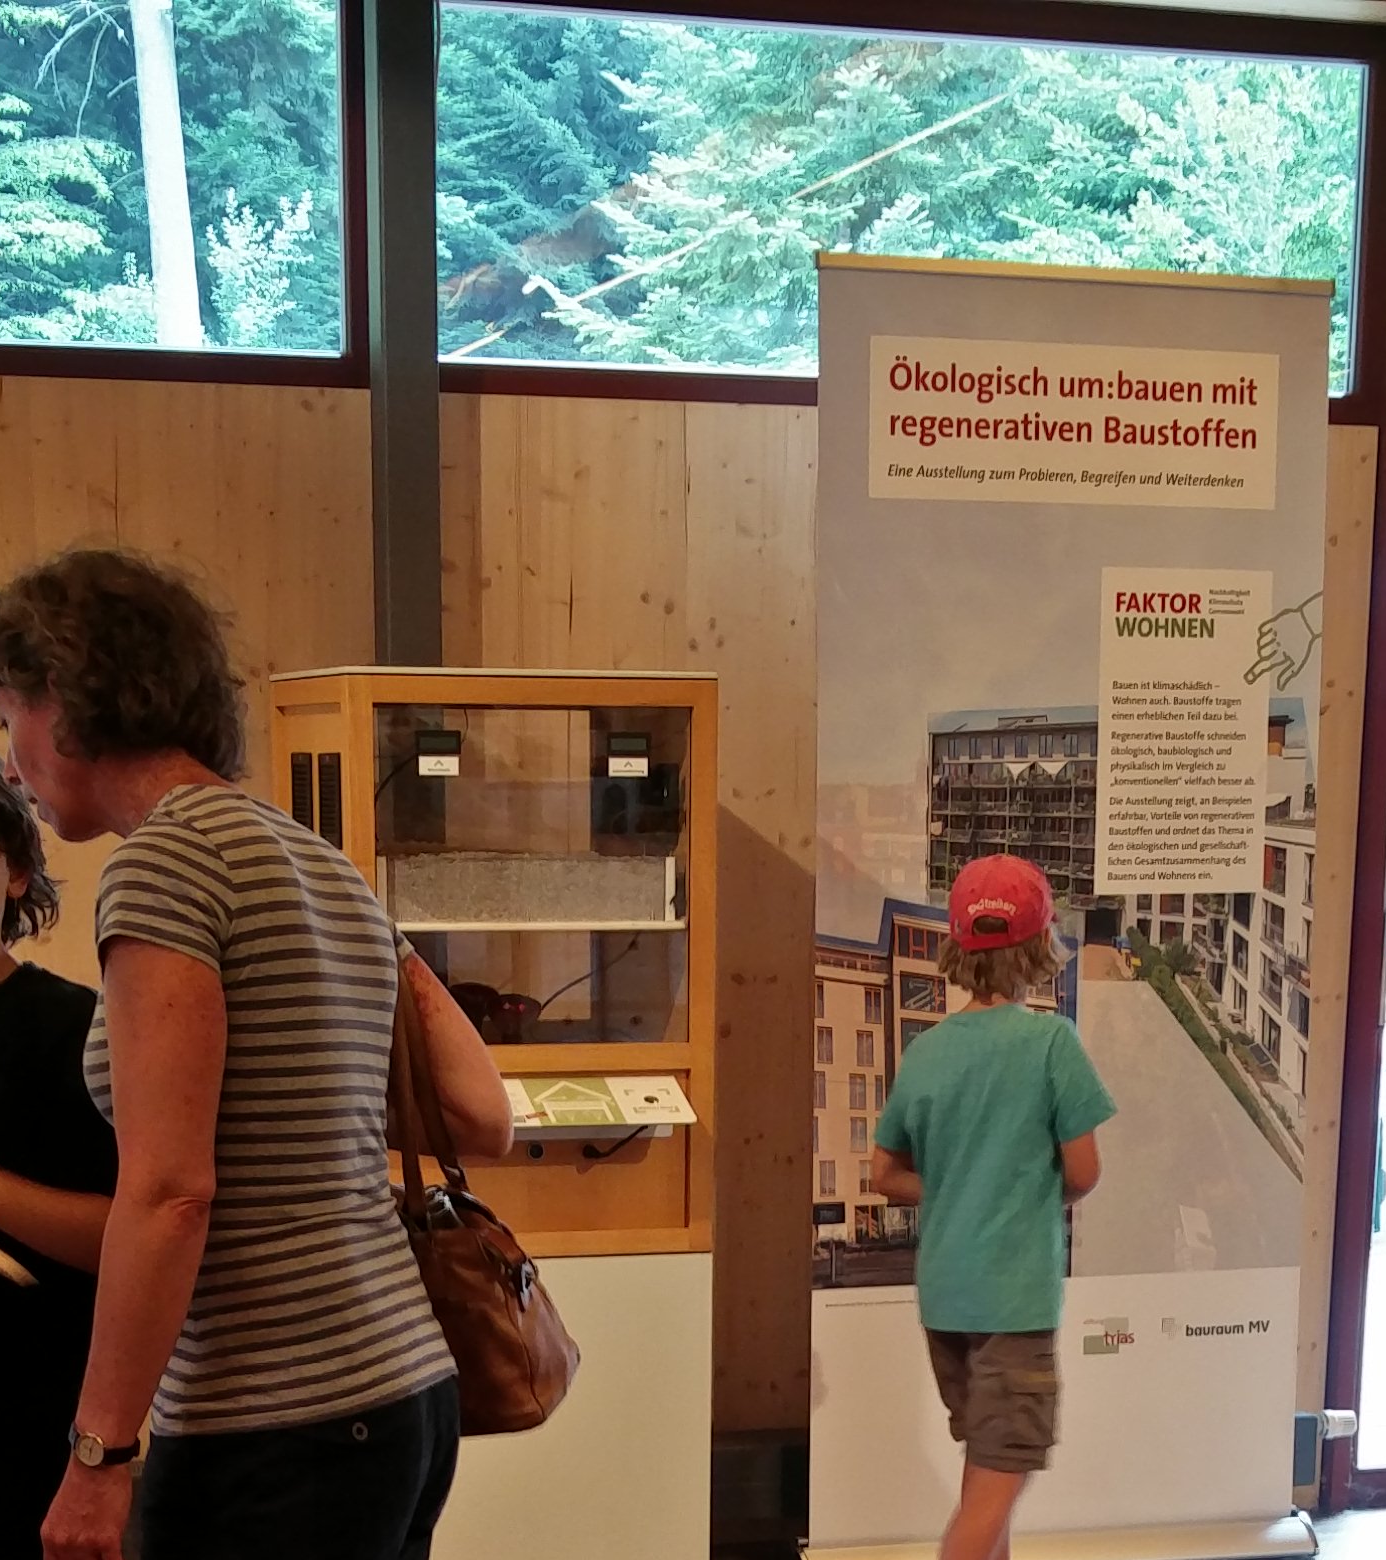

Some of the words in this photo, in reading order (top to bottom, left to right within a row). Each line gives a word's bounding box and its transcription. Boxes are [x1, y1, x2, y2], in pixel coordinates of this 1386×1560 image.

[889, 355, 1048, 403] Ökologisch
[1059, 370, 1202, 403] um:bauen
[1213, 377, 1257, 405] mit
[889, 412, 1092, 447] regenerativen
[1104, 416, 1257, 449] Baustoffen
[888, 464, 913, 478] Eine
[916, 465, 985, 483] Ausstellung
[989, 470, 1015, 481] zum
[1019, 467, 1077, 485] Probieren,
[1081, 469, 1135, 489] Begreifen
[1139, 472, 1162, 486] und
[1165, 472, 1244, 488] Weiterdenken
[1116, 592, 1201, 613] FAKTOR
[1116, 617, 1214, 638] WOHNEN
[1113, 681, 1138, 689] Bauen
[1141, 681, 1150, 689] ist
[1153, 681, 1212, 690] klimaschädlich
[1113, 696, 1147, 705] Wohnen
[1173, 696, 1213, 705] Baustoffe
[1216, 697, 1241, 708] tragen
[1112, 712, 1134, 720] einen
[1137, 712, 1184, 720] erheblichen
[1188, 712, 1200, 720] Teil
[1203, 712, 1221, 720] dazu
[1111, 731, 1163, 742] Regenerative
[1166, 730, 1204, 740] Baustoffe
[1207, 731, 1246, 740] schneiden
[1158, 746, 1213, 758] baubiologisch
[1216, 747, 1232, 755] und
[1110, 761, 1159, 773] physikalisch
[1176, 762, 1213, 773] Vergleich
[1185, 776, 1215, 785] vielfach
[1218, 776, 1242, 785] besser
[1109, 796, 1123, 805] Die
[1125, 796, 1173, 808] Ausstellung
[1151, 811, 1181, 820] Vorteile
[1201, 812, 1255, 822] regenerativen
[1109, 826, 1152, 836] Baustoffen
[1155, 826, 1171, 835] und
[1173, 826, 1199, 835] ordnet
[1202, 826, 1215, 835] das
[1218, 826, 1245, 835] Thema
[1246, 826, 1253, 834] in
[1108, 842, 1123, 850] den
[1126, 841, 1179, 853] ökologischen
[1182, 840, 1198, 850] und
[1135, 856, 1231, 867] Gesamtzusammenhang
[1232, 855, 1246, 865] des
[1107, 871, 1137, 880] Bauens
[1140, 871, 1155, 880] und
[1157, 871, 1196, 880] Wohnens
[1185, 1322, 1245, 1337] bauraum
[1248, 1320, 1270, 1333] MV
[1103, 1331, 1135, 1346] trias
